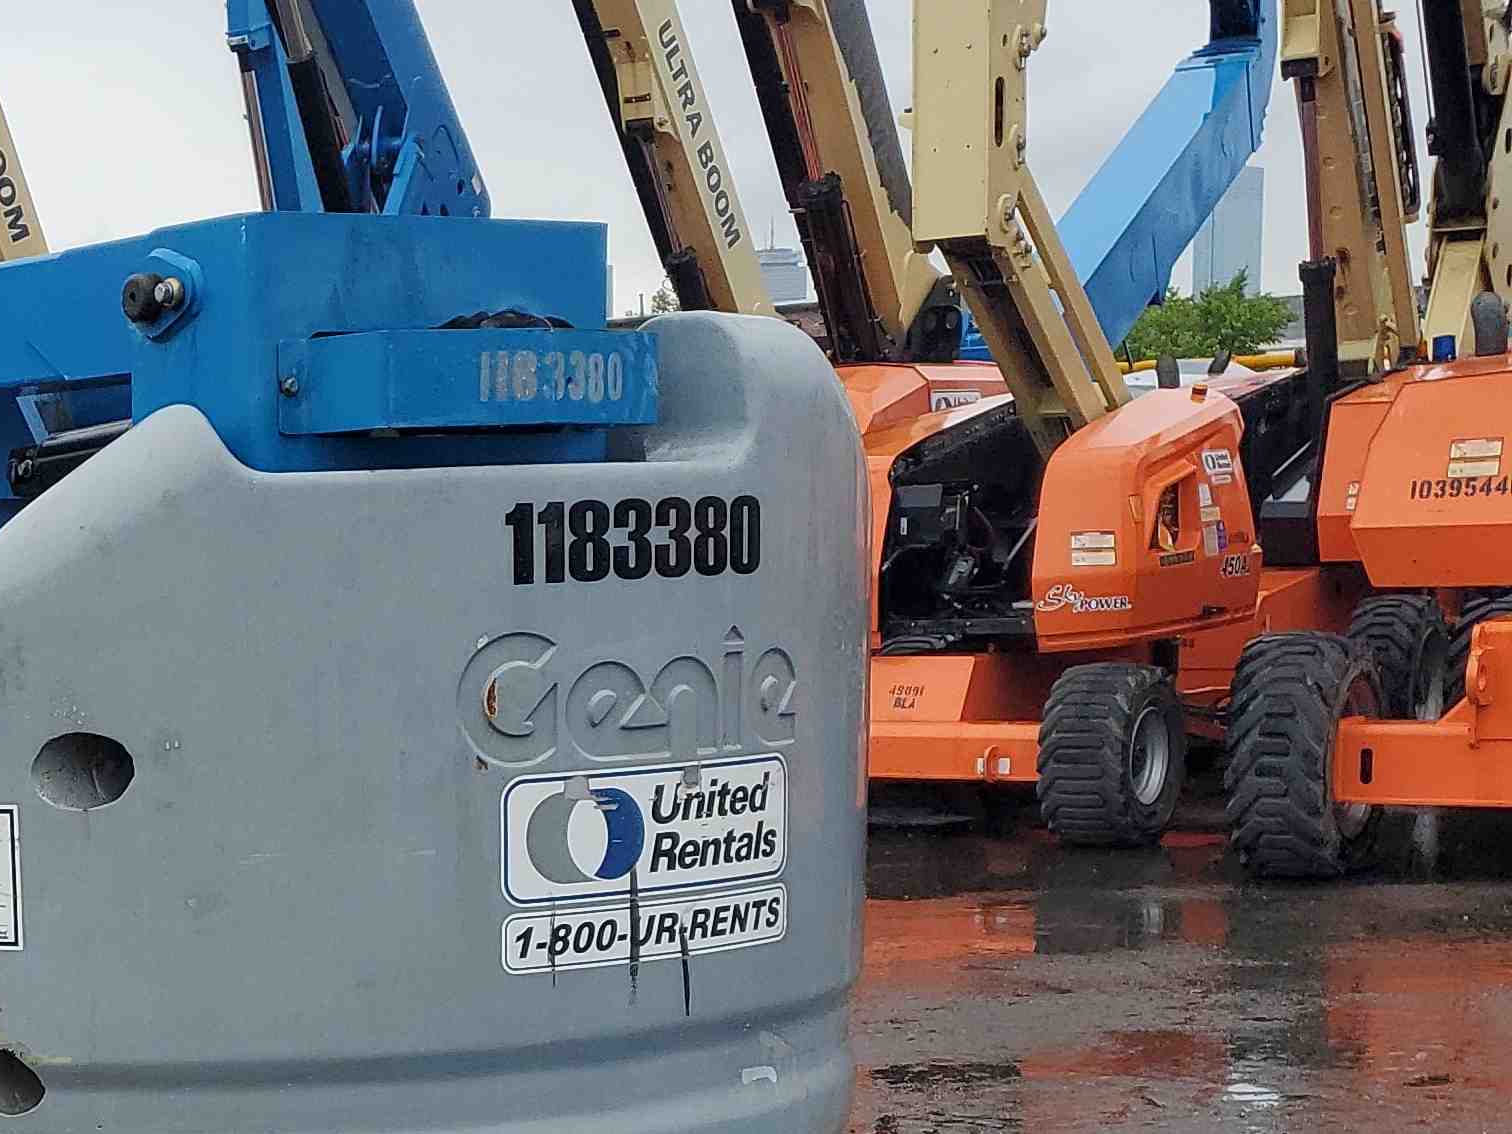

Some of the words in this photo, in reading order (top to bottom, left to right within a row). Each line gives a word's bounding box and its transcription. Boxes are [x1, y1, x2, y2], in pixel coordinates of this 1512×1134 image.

[658, 19, 704, 138] ULTRA
[697, 140, 741, 249] BOOM
[1410, 476, 1512, 500] 1039544
[505, 496, 761, 585] 1183380
[457, 624, 796, 768] Genie
[649, 772, 771, 826] United
[648, 822, 777, 874] Rentals
[514, 896, 780, 960] 1-800-UR-RENTS
